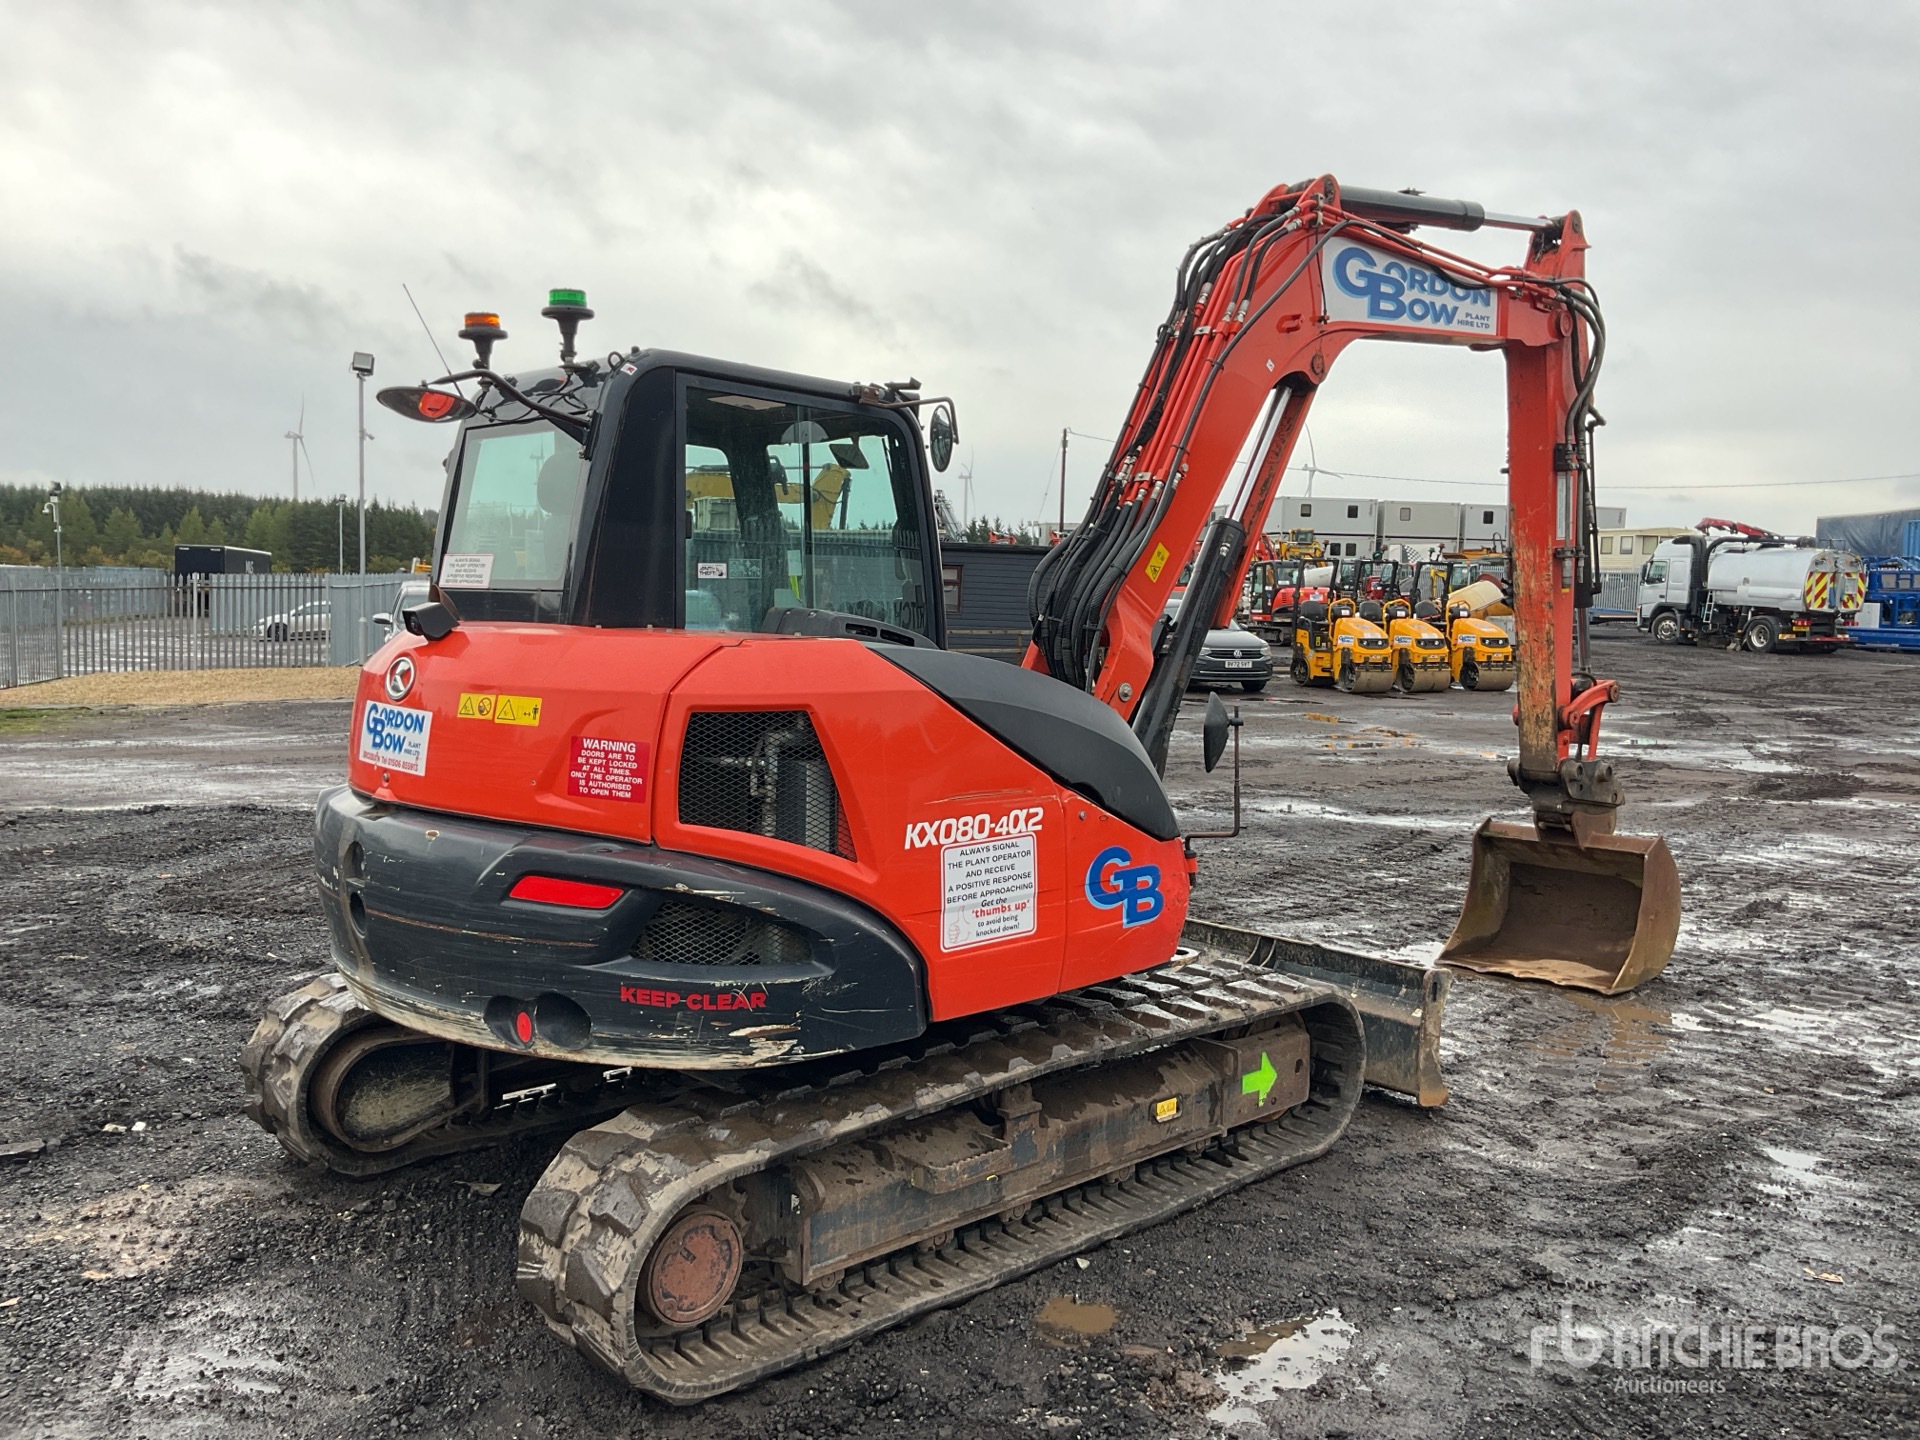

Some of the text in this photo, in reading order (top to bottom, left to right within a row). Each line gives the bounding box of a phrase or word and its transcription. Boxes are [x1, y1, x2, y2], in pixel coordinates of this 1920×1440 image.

[1356, 269, 1459, 325] BOW
[1457, 319, 1475, 327] HIRE
[1465, 312, 1490, 321] PLANT
[367, 703, 425, 735] GORDON
[371, 717, 406, 754] BOW
[583, 738, 636, 753] WARNING
[581, 750, 605, 758] DOORS
[609, 761, 637, 769] LOCKED
[588, 781, 632, 790] AUTHORISED
[606, 775, 643, 784] OPERATOR
[590, 788, 609, 796] OPEN
[612, 790, 631, 798] THEM
[960, 841, 1019, 856] ALWAYS SIGNAL
[948, 850, 1031, 869] THE PLANT OPERATOR
[965, 864, 1015, 878] AND RECEIVE
[956, 879, 990, 891] POSITIVE
[993, 871, 1031, 884] RESPONSE
[947, 882, 1033, 904] BEFORE APPROACHING
[986, 916, 1001, 926] avoid
[1003, 914, 1018, 923] being
[976, 923, 1020, 937] knocked down!
[620, 985, 766, 1010] KEEP CLEAR
